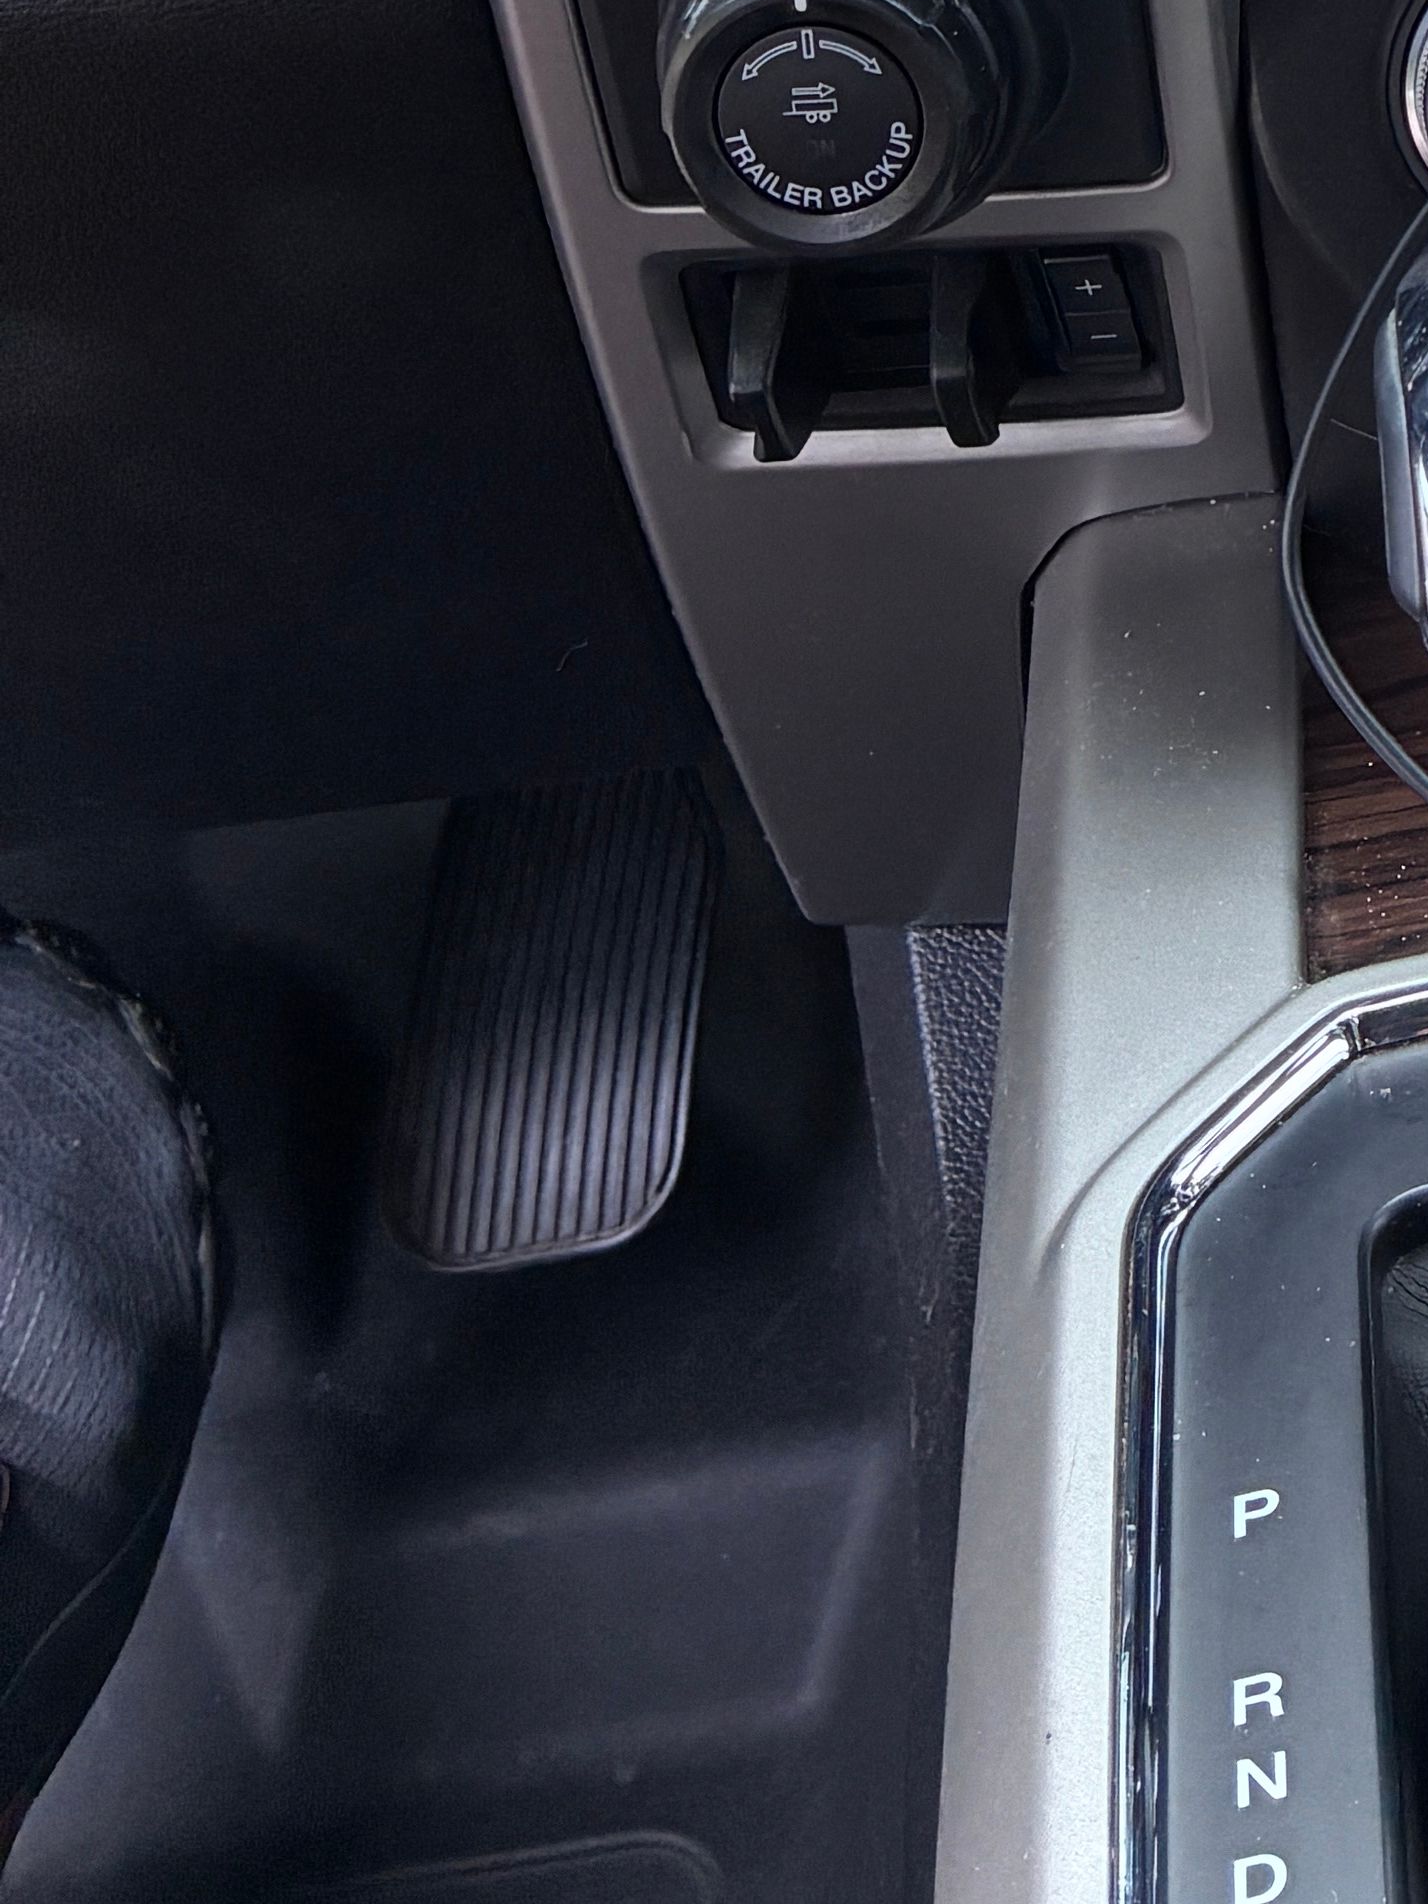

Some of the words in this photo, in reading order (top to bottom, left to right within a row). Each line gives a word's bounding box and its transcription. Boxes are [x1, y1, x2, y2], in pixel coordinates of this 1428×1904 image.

[725, 128, 823, 209] TRAILER
[830, 121, 914, 208] BACKUP
[1232, 1488, 1280, 1539] P
[1232, 1671, 1285, 1727] R
[1236, 1750, 1287, 1809] N
[1232, 1853, 1288, 1904] D
